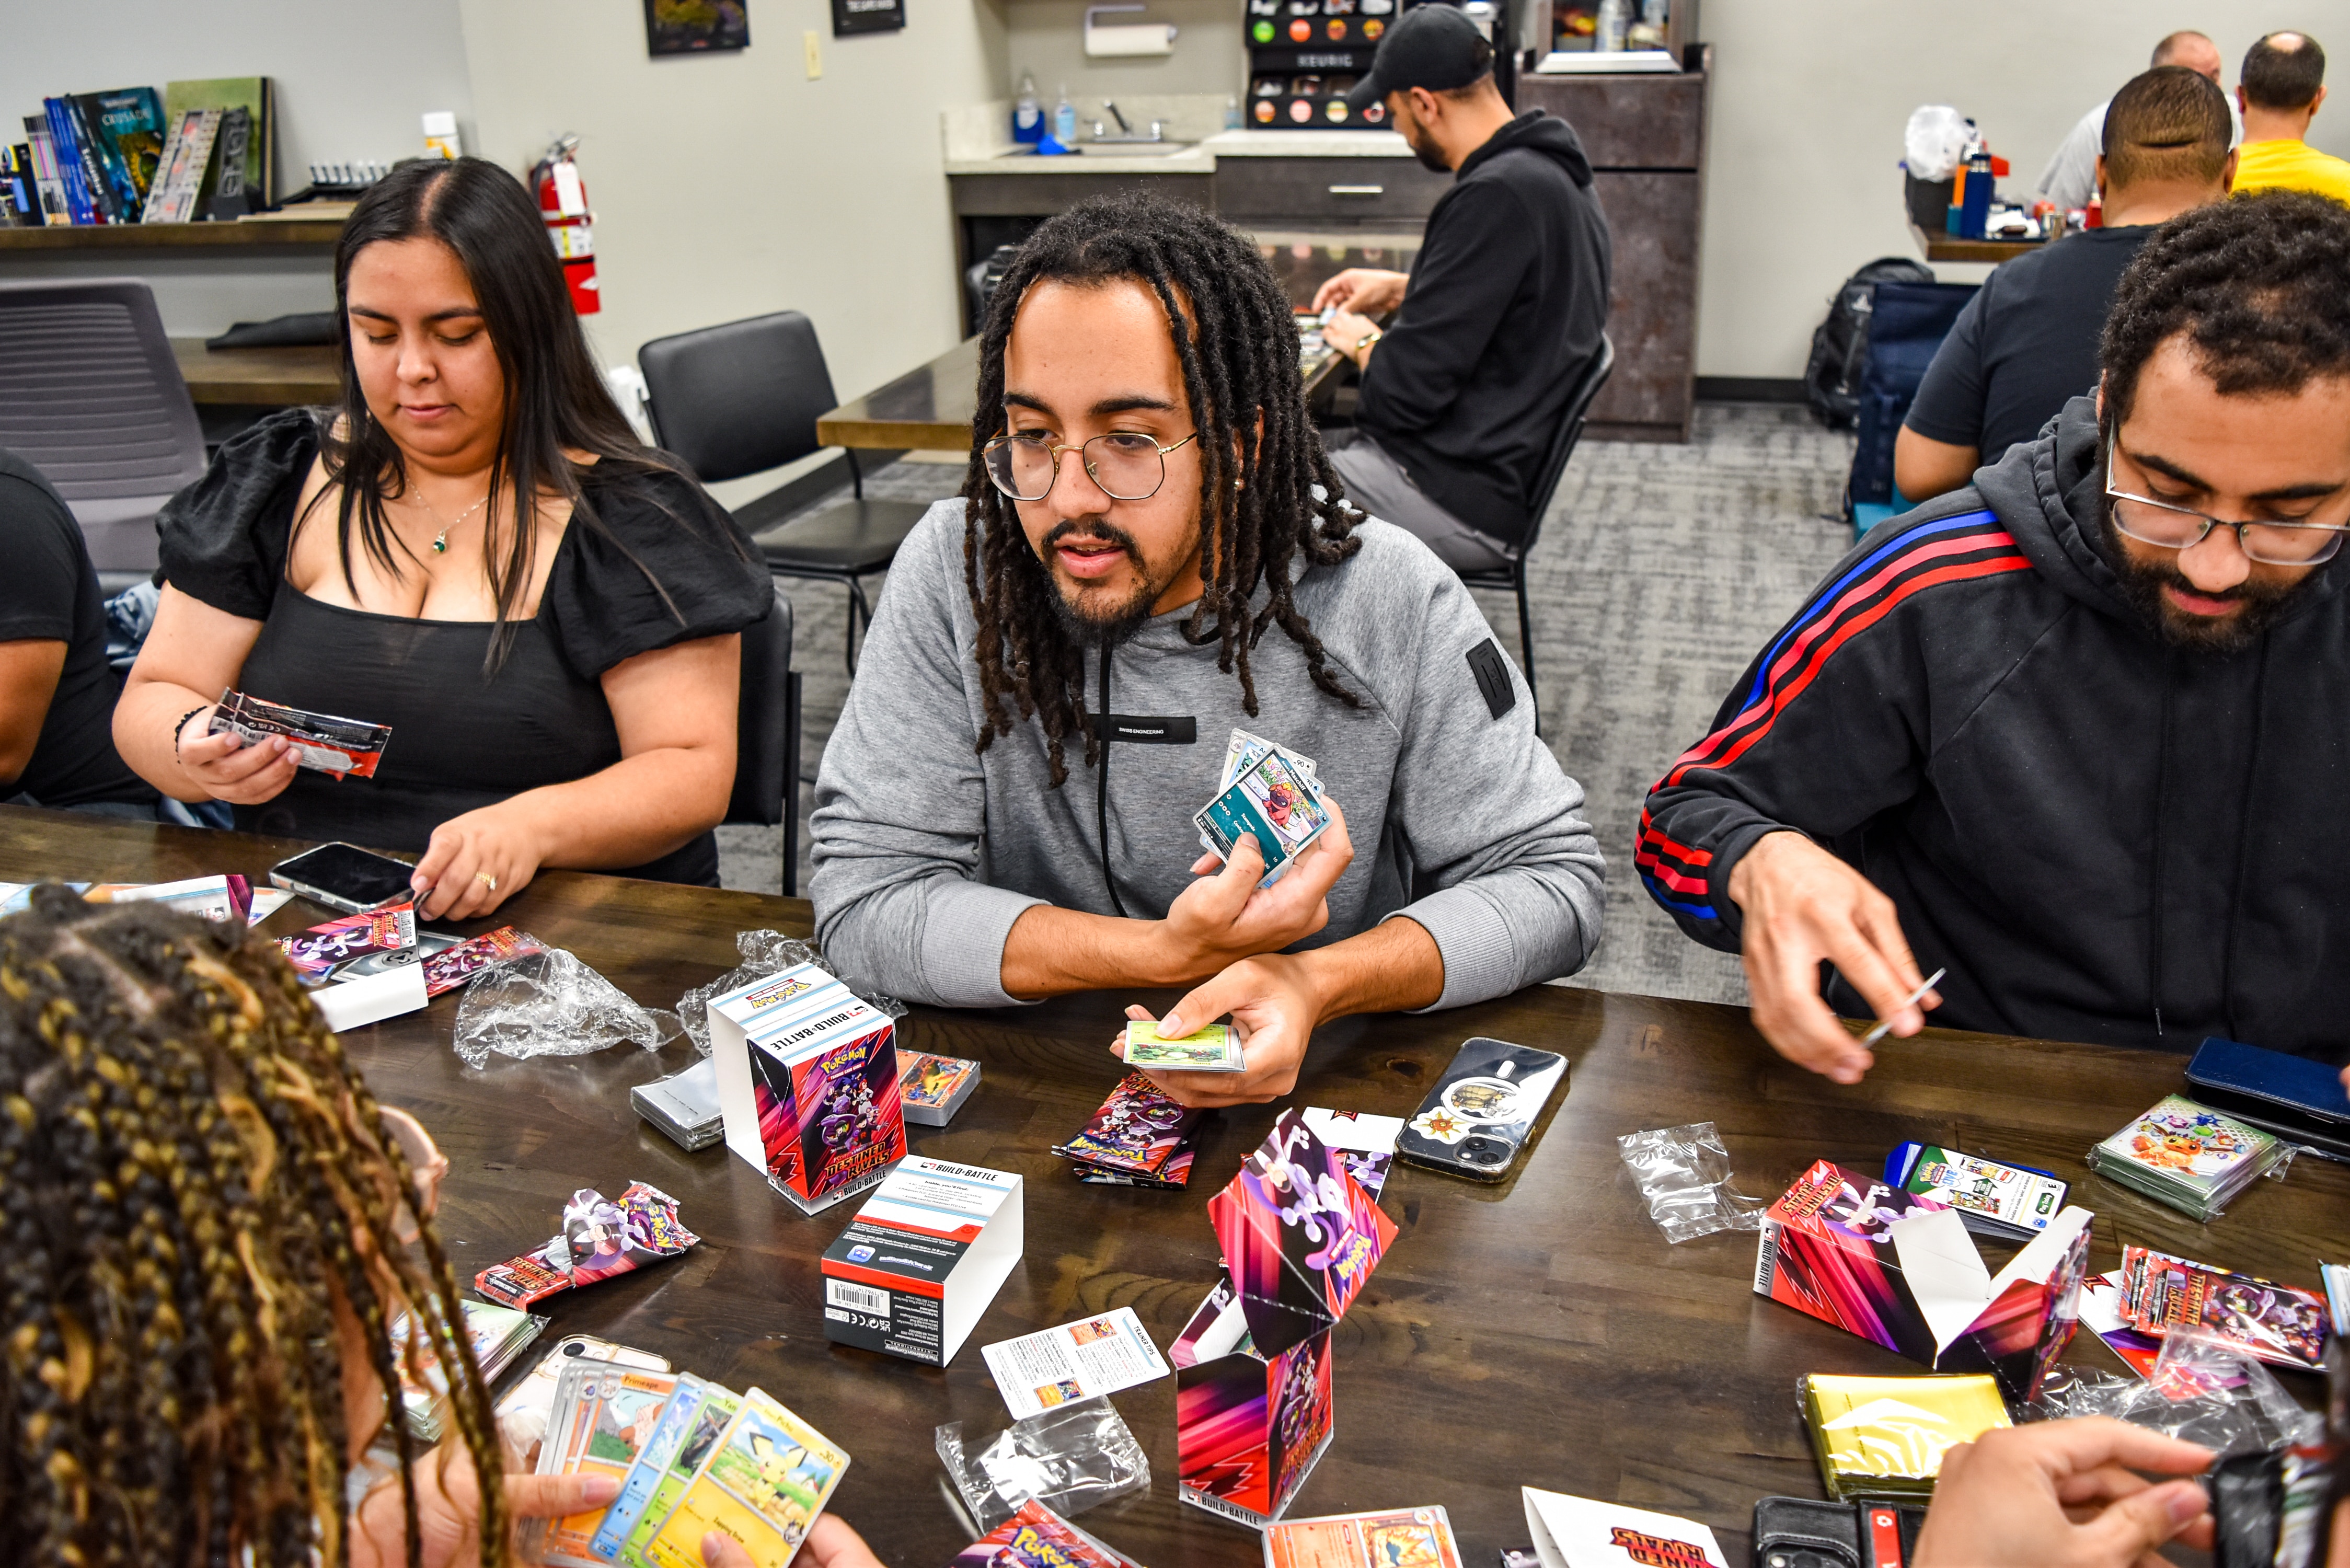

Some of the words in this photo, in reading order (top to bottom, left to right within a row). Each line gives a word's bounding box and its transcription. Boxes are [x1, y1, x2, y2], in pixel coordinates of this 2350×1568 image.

[1297, 53, 1353, 68] KEURIG
[101, 108, 152, 126] CRUSADE
[1289, 769, 1306, 791] Maschiff
[1241, 813, 1255, 832] Stampede
[1316, 809, 1323, 817] 70
[373, 918, 384, 947] DESTINED
[752, 982, 812, 1009] Pokémon
[819, 1013, 850, 1031] BUILD
[770, 1029, 814, 1051] BATTLE
[821, 1047, 867, 1074] Pokémon
[825, 1142, 885, 1178] DESTINED
[1070, 1135, 1147, 1162] Pokémon
[848, 1150, 890, 1179] RIVALS
[936, 1165, 962, 1175] BUILD
[964, 1170, 998, 1181] BATTLE
[1919, 1161, 1939, 1182] Pokémon
[844, 1182, 862, 1195] BUILD
[864, 1170, 886, 1187] BATTLE
[1942, 1169, 1958, 1187] LIVE
[778, 1182, 788, 1194] BUILD
[790, 1192, 805, 1208] BATTLE
[1781, 1182, 1815, 1214] RIVALS
[1798, 1174, 1845, 1217] DESTINED
[2008, 1208, 2018, 1220] Available
[2015, 1197, 2023, 1206] mobile,
[2024, 1175, 2032, 1185] desktop
[2038, 1203, 2047, 1214] Play
[2043, 1194, 2052, 1205] Today
[1335, 1233, 1372, 1280] Pokémon
[1762, 1240, 1772, 1261] BUILD
[504, 1256, 556, 1281] DESTINED
[1759, 1261, 1770, 1287] BATTLE
[879, 1324, 890, 1333] UK
[1133, 1325, 1149, 1345] TRAINER
[1144, 1344, 1155, 1356] TIPS
[624, 1376, 659, 1390] Primeape
[776, 1416, 794, 1433] Pichu
[824, 1450, 835, 1463] 30
[1202, 1496, 1225, 1512] BUILD
[1229, 1507, 1258, 1525] BATTLE
[713, 1516, 733, 1536] Zapping
[731, 1530, 744, 1544] Draw
[1010, 1526, 1079, 1568] Poké
[1609, 1527, 1706, 1561] RIVALS
[769, 1560, 778, 1568] 30
